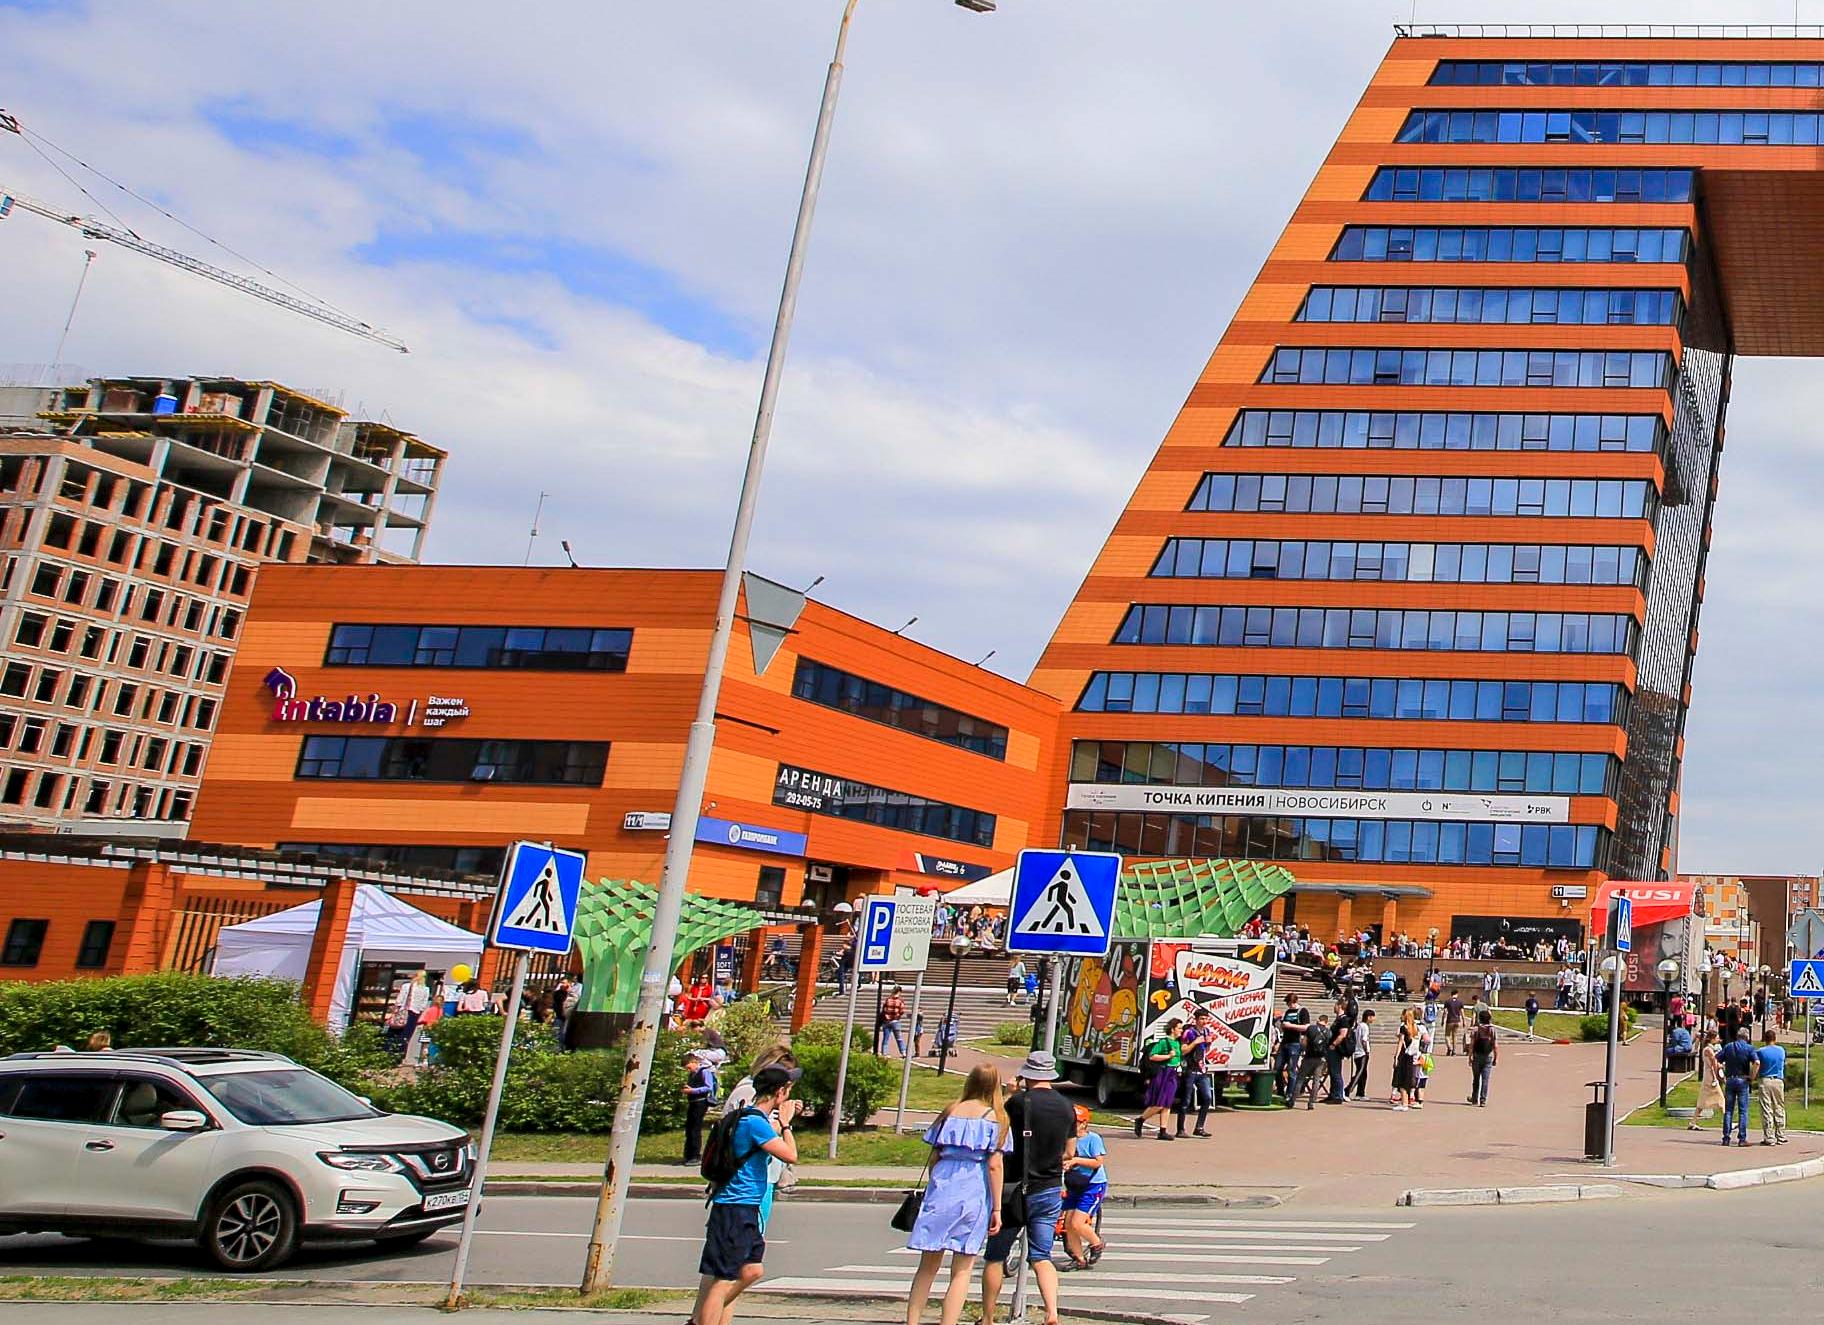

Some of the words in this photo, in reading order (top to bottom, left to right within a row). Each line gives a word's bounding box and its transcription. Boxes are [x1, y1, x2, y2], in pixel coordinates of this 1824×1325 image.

[272, 690, 397, 723] intabia
[428, 696, 463, 706] Важен
[426, 706, 469, 717] каждый
[423, 718, 445, 727] шаг
[779, 768, 842, 797] АРЕНДА
[786, 791, 822, 810] 292-05-75
[1144, 792, 1192, 805] ТОЧКА
[1196, 793, 1265, 807] КИПЕНИЯ
[1276, 796, 1386, 811] НОВОСИБИРСК
[625, 815, 644, 826] 11/1
[1554, 887, 1563, 895] 11
[897, 904, 933, 914] ГОСТЕВАЯ
[895, 916, 930, 926] ПАРКОВКА
[1628, 953, 1639, 982] GUSI
[1225, 1005, 1266, 1020] КЛАССИКА
